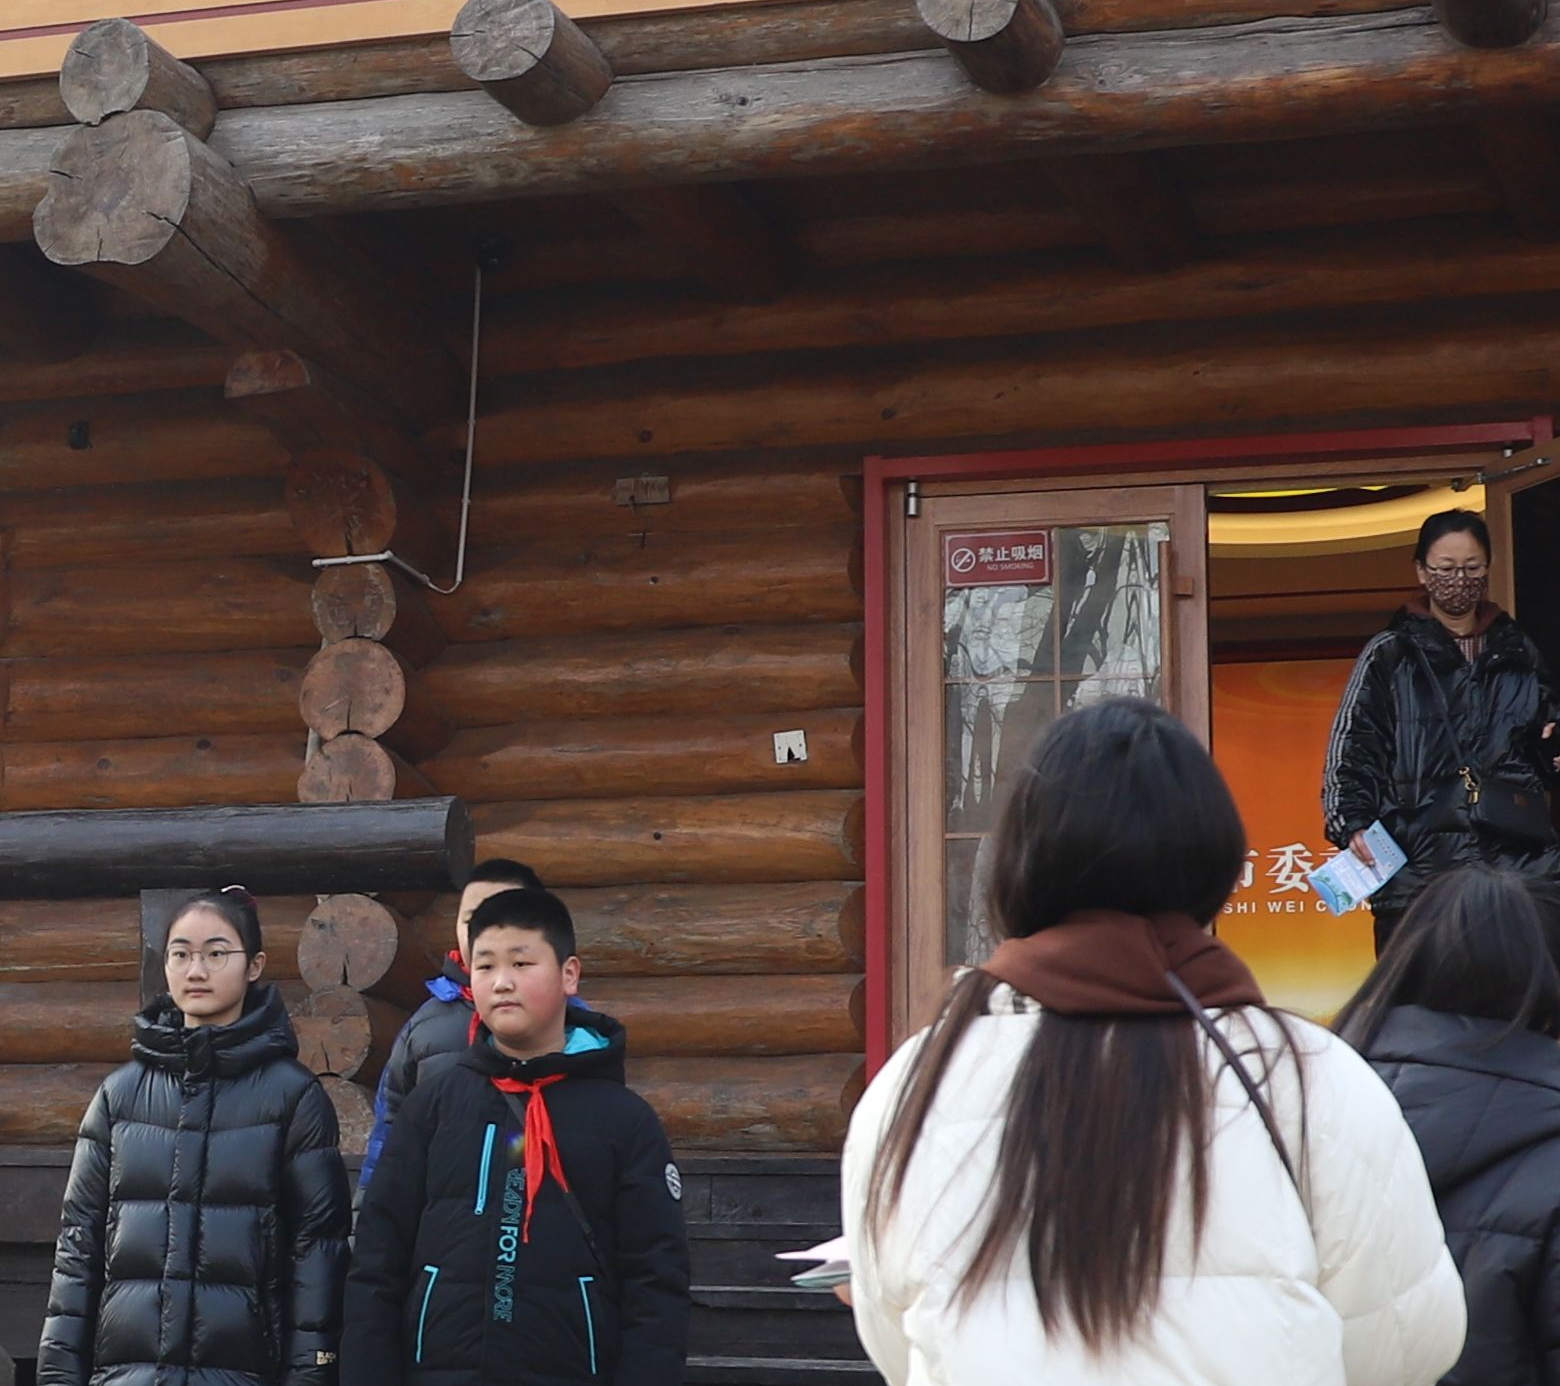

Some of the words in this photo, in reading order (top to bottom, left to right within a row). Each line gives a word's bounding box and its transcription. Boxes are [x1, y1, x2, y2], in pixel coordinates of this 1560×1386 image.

[978, 544, 1044, 563] 禁止吸烟
[1000, 562, 1034, 571] SMOKING
[1223, 902, 1256, 914] SHI
[1267, 900, 1305, 913] WEI
[497, 1225, 520, 1263] FOR
[493, 1264, 516, 1323] MORE
